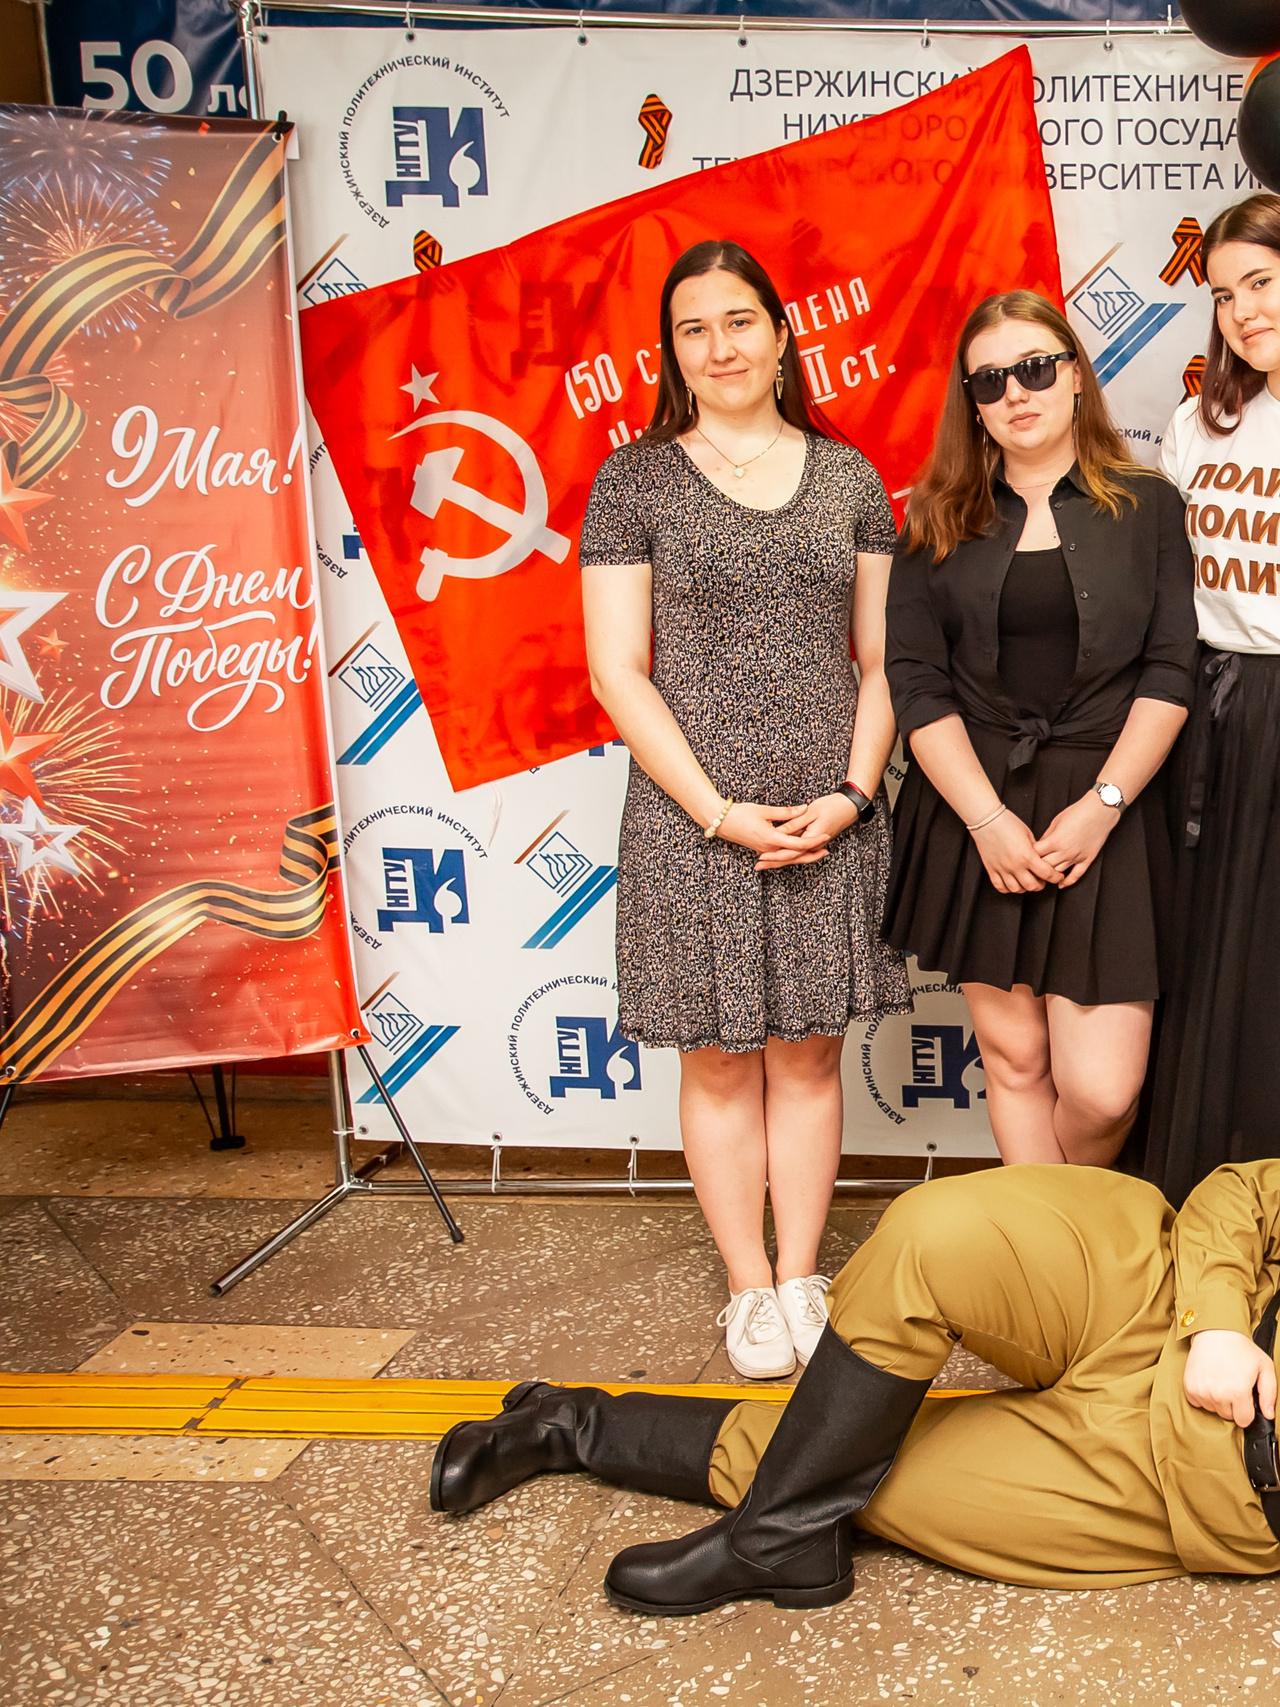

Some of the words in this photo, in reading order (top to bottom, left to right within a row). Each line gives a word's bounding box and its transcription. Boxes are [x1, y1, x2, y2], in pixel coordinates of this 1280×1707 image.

[80, 39, 193, 114] 50
[343, 55, 451, 127] ПОЛИТЕХНИЧЕСКИЙ
[454, 63, 510, 118] ИНСТИТУТ
[730, 67, 980, 102] ДЗЕРЖИНСКИ
[1034, 75, 1243, 103] ОЛИТЕХНИЧЕ
[1117, 118, 1238, 151] ГОСУДА
[338, 131, 390, 229] ДЗЕРЖИНСКИЙ
[1045, 163, 1224, 190] ВЕРСИТЕТА
[784, 276, 871, 337] ДЕНА
[106, 405, 159, 489] 9
[124, 425, 302, 507] Мая!
[95, 544, 151, 629] С
[154, 543, 317, 618] Днем
[100, 610, 321, 733] Победы!
[436, 812, 489, 859] ИНСТИТУТ
[511, 975, 608, 1032] ПОЛИТЕХНИЧЕСКИЙ
[508, 1035, 555, 1116] ДЗЕРЖИНСКИЙ
[861, 1043, 906, 1125] ДЗЕРЖИНСКИЙ
